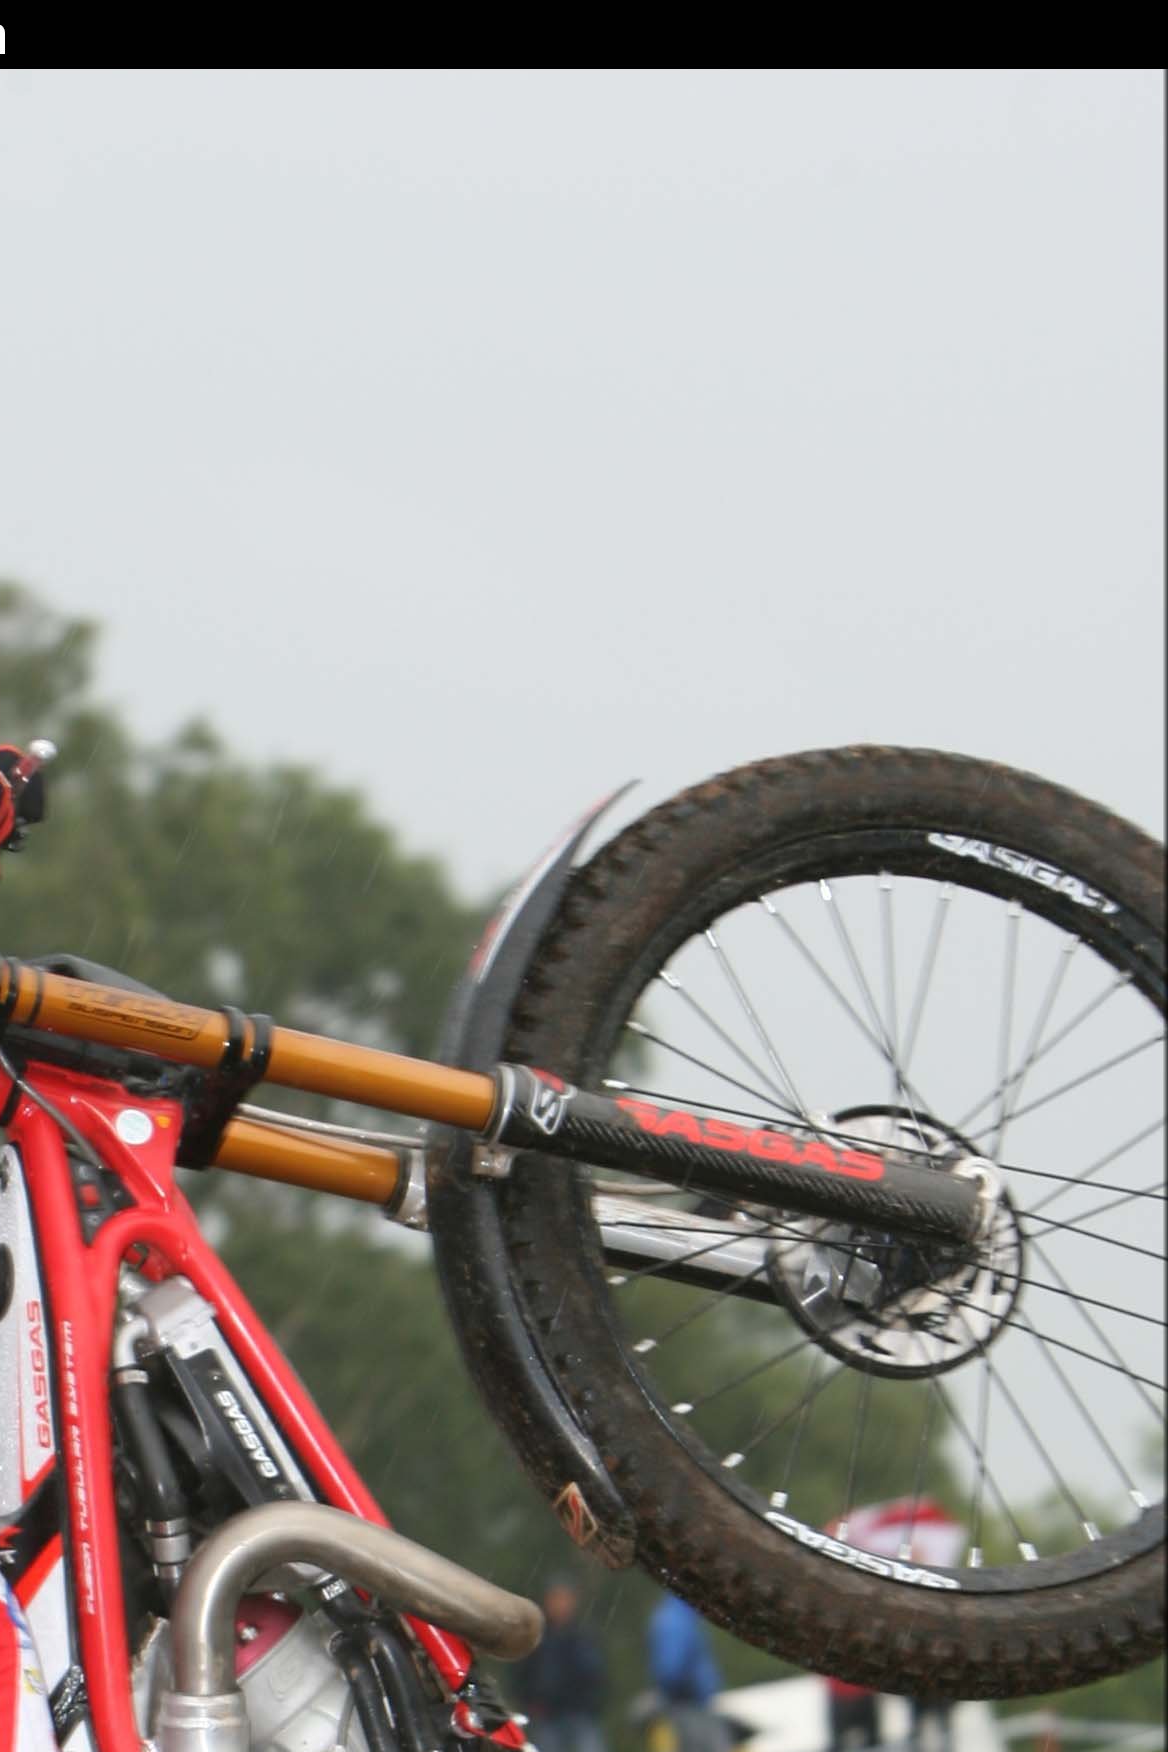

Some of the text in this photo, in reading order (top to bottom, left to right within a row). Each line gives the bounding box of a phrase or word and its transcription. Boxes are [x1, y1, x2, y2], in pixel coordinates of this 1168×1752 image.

[927, 832, 1121, 914] GASGAS
[26, 1300, 51, 1448] GASGAS
[214, 1389, 280, 1479] GASGAS
[764, 1511, 962, 1590] GASGAS
